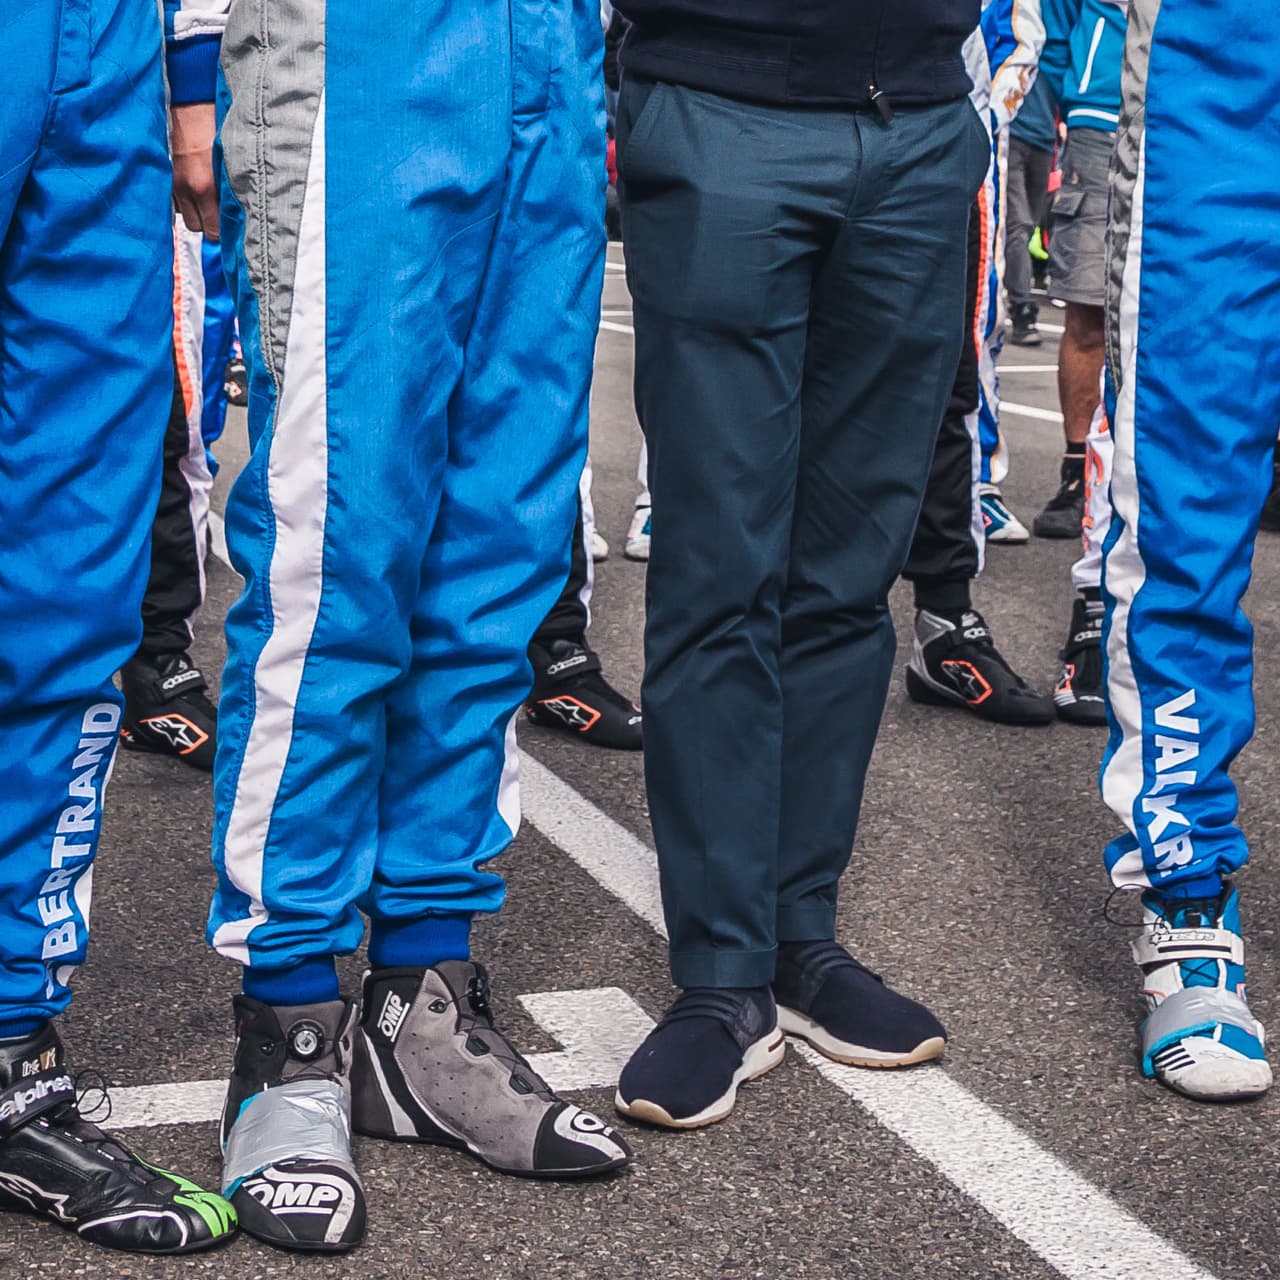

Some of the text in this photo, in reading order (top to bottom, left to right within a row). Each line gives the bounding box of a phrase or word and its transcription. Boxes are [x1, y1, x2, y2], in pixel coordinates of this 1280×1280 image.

[40, 702, 122, 961] BERTRAND
[381, 993, 404, 1037] OMP
[247, 1182, 340, 1208] OMP
